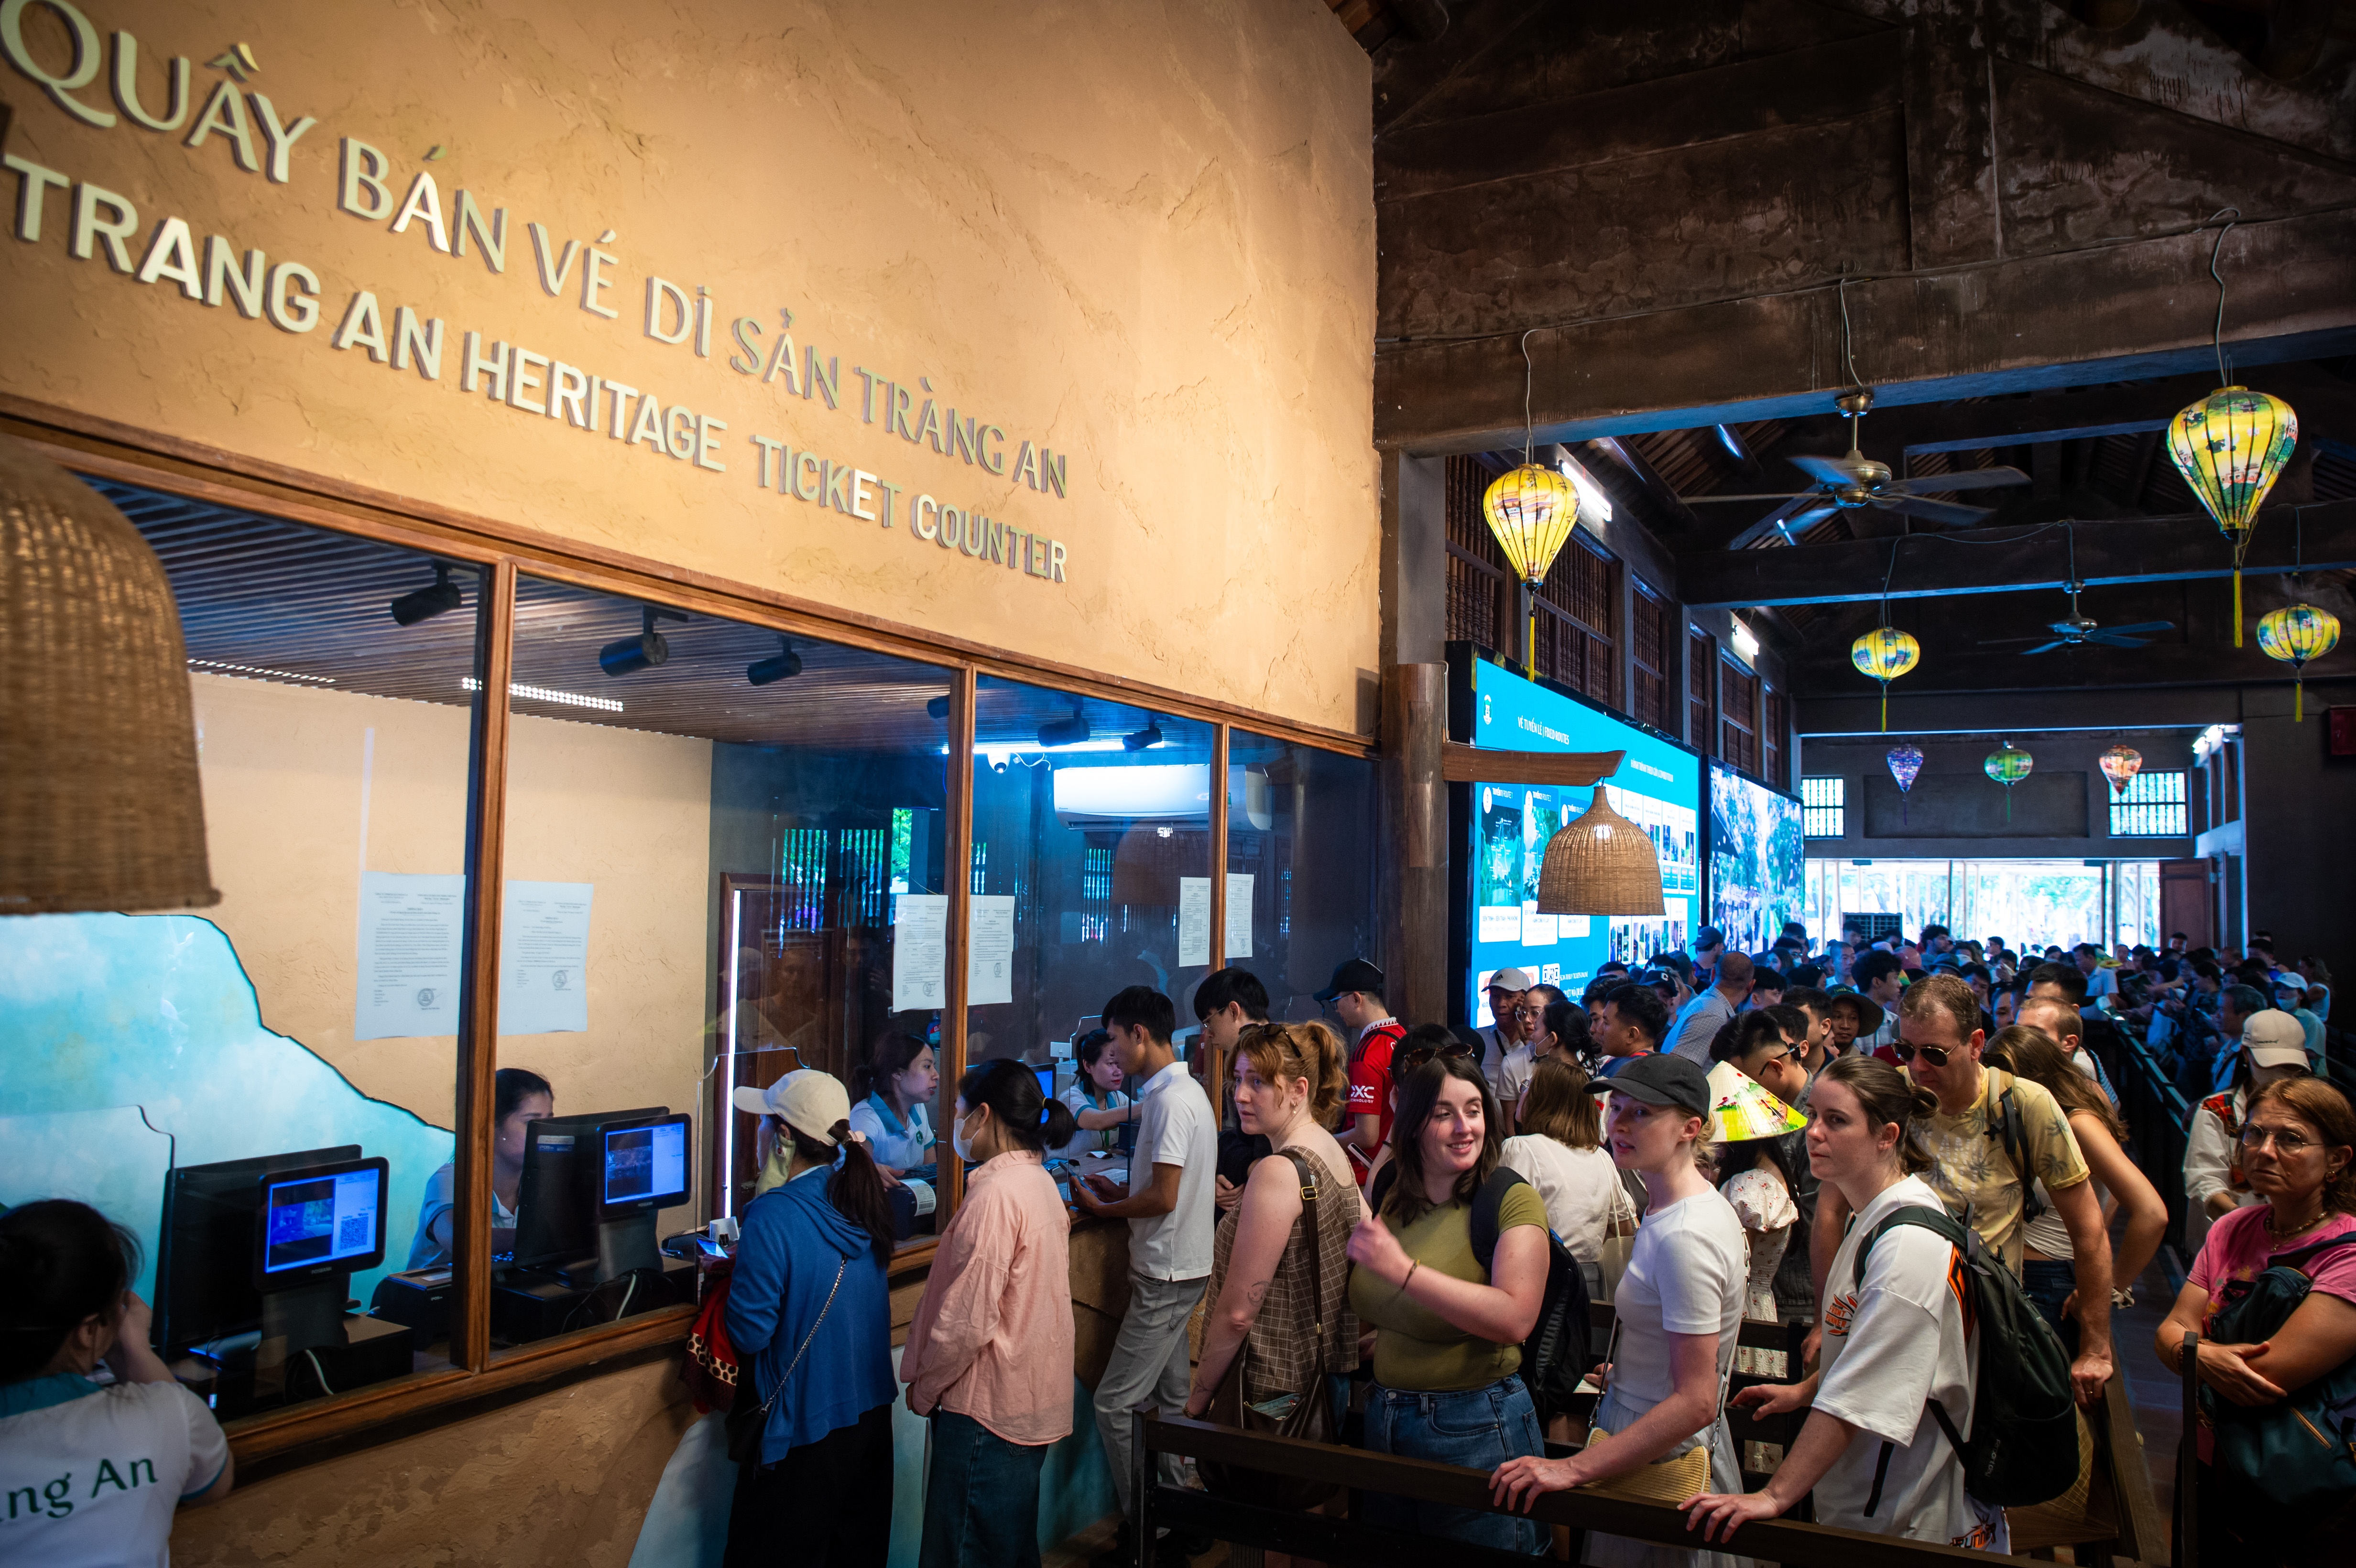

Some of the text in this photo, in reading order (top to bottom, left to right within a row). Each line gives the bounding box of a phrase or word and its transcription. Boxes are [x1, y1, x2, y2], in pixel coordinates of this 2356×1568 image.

[0, 0, 317, 183] QUẦY
[337, 137, 509, 273] BÁN
[529, 222, 620, 320] VÉ
[731, 308, 841, 410] SẢN
[854, 366, 1006, 475] TRÀNG
[1014, 440, 1068, 499] AN
[3, 153, 1067, 583] TRANG AN HERITAGE TICKET COUNTER
[1825, 1313, 1847, 1328] RUNNER
[1829, 1305, 1846, 1318] FRONT
[0, 1457, 158, 1520] ng An
